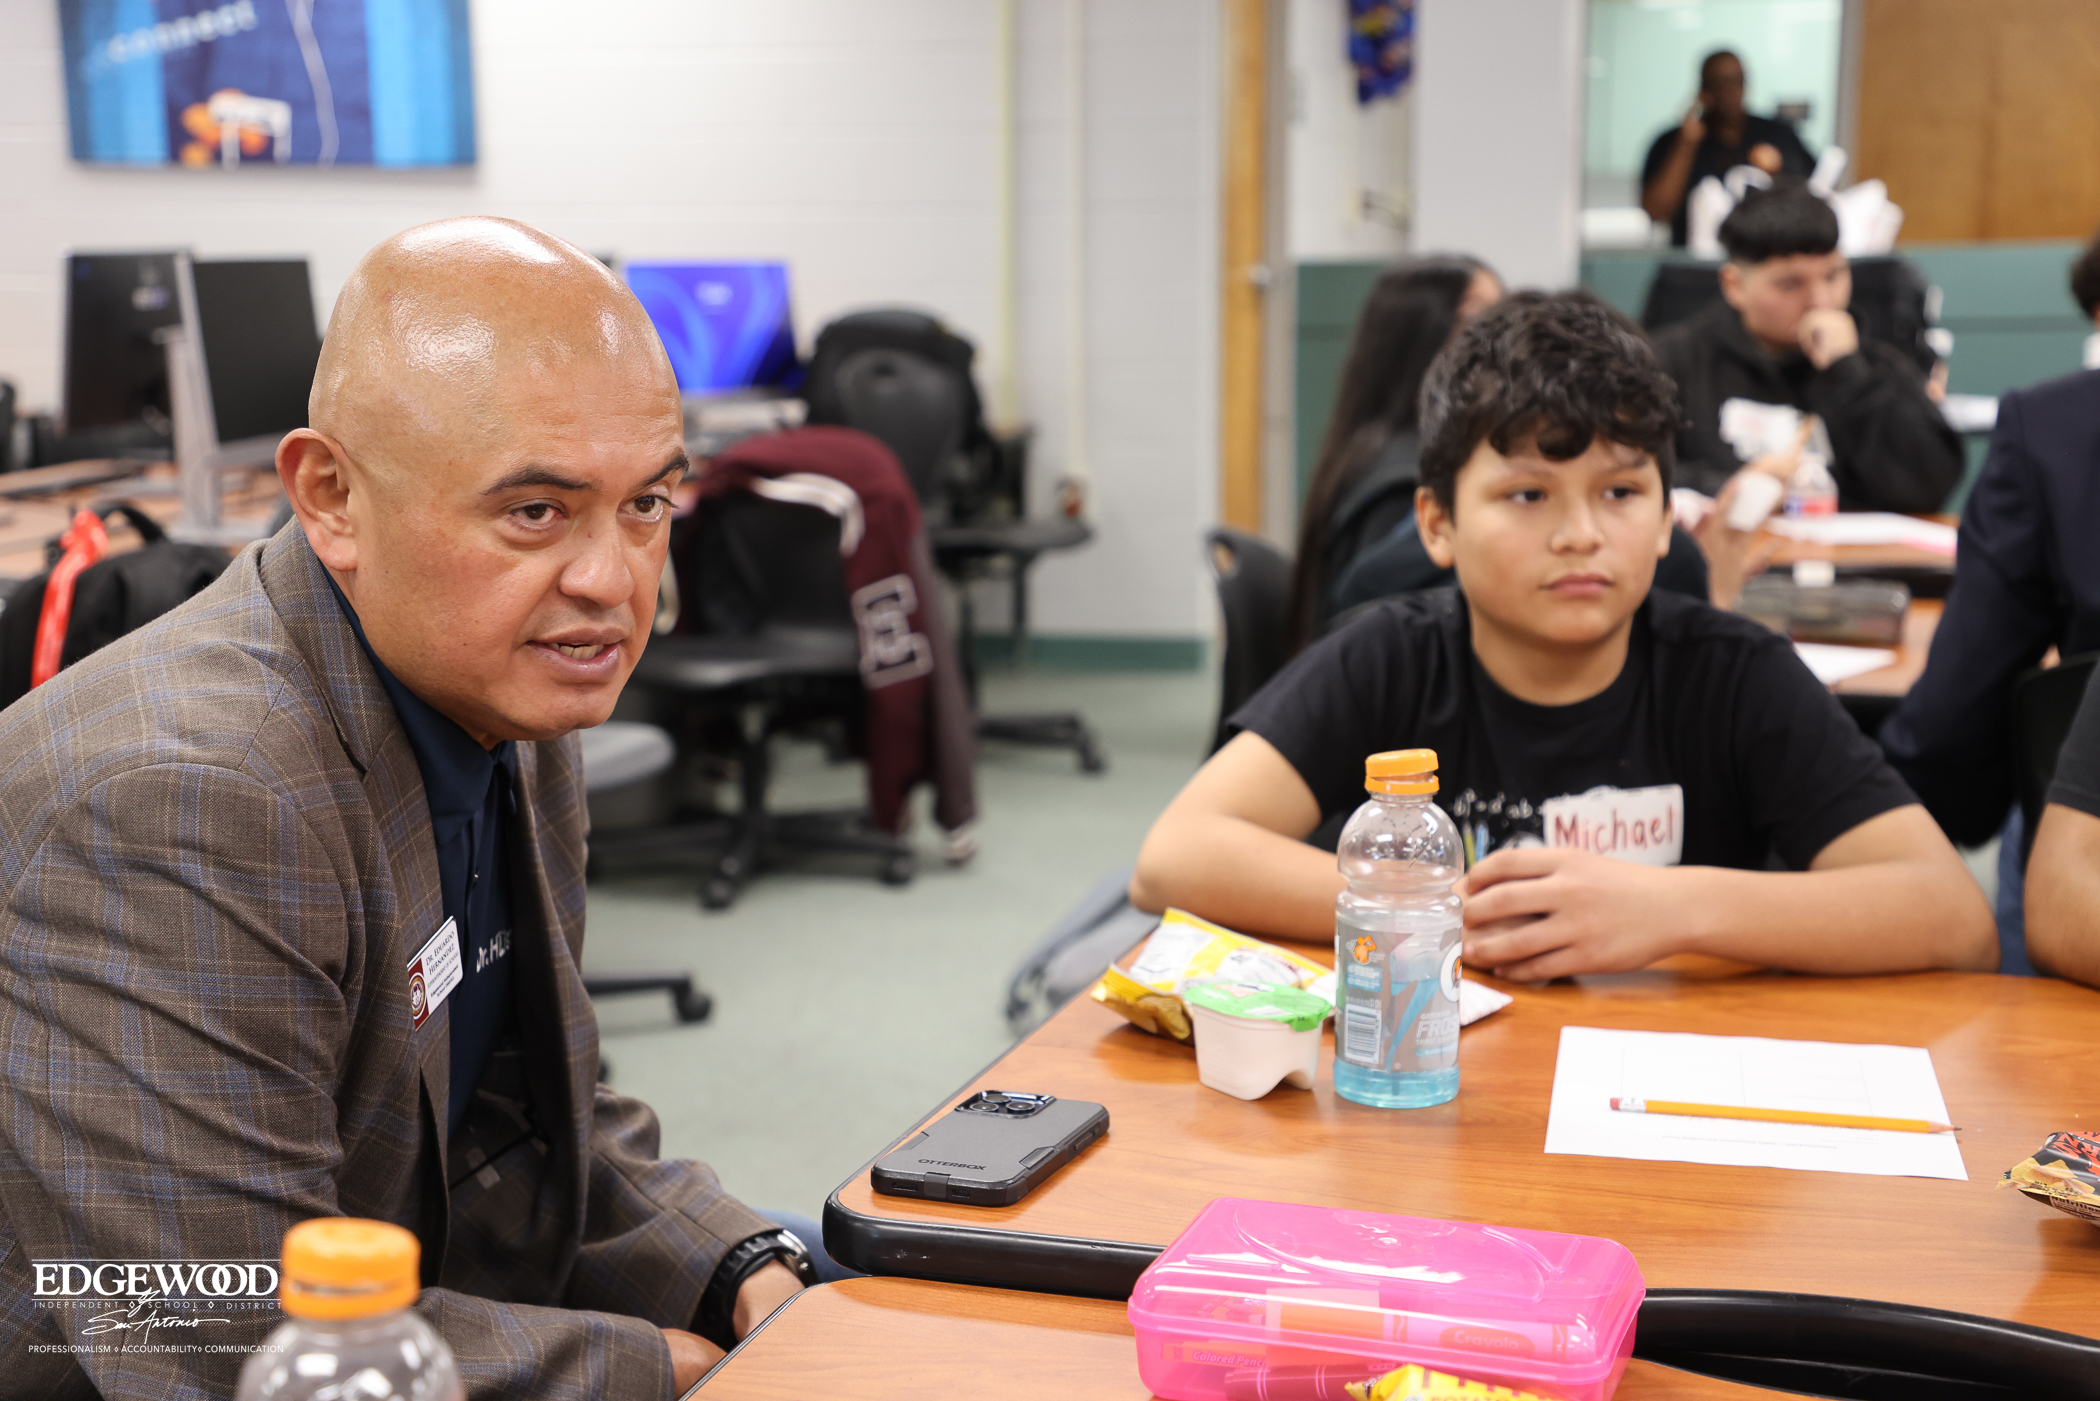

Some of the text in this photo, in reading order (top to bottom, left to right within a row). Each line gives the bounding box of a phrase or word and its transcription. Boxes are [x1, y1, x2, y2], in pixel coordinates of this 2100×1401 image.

[1555, 803, 1673, 854] Michael
[918, 1158, 986, 1170] OTTERBOX
[1453, 1329, 1520, 1351] Crayola
[1193, 1350, 1236, 1365] Colored
